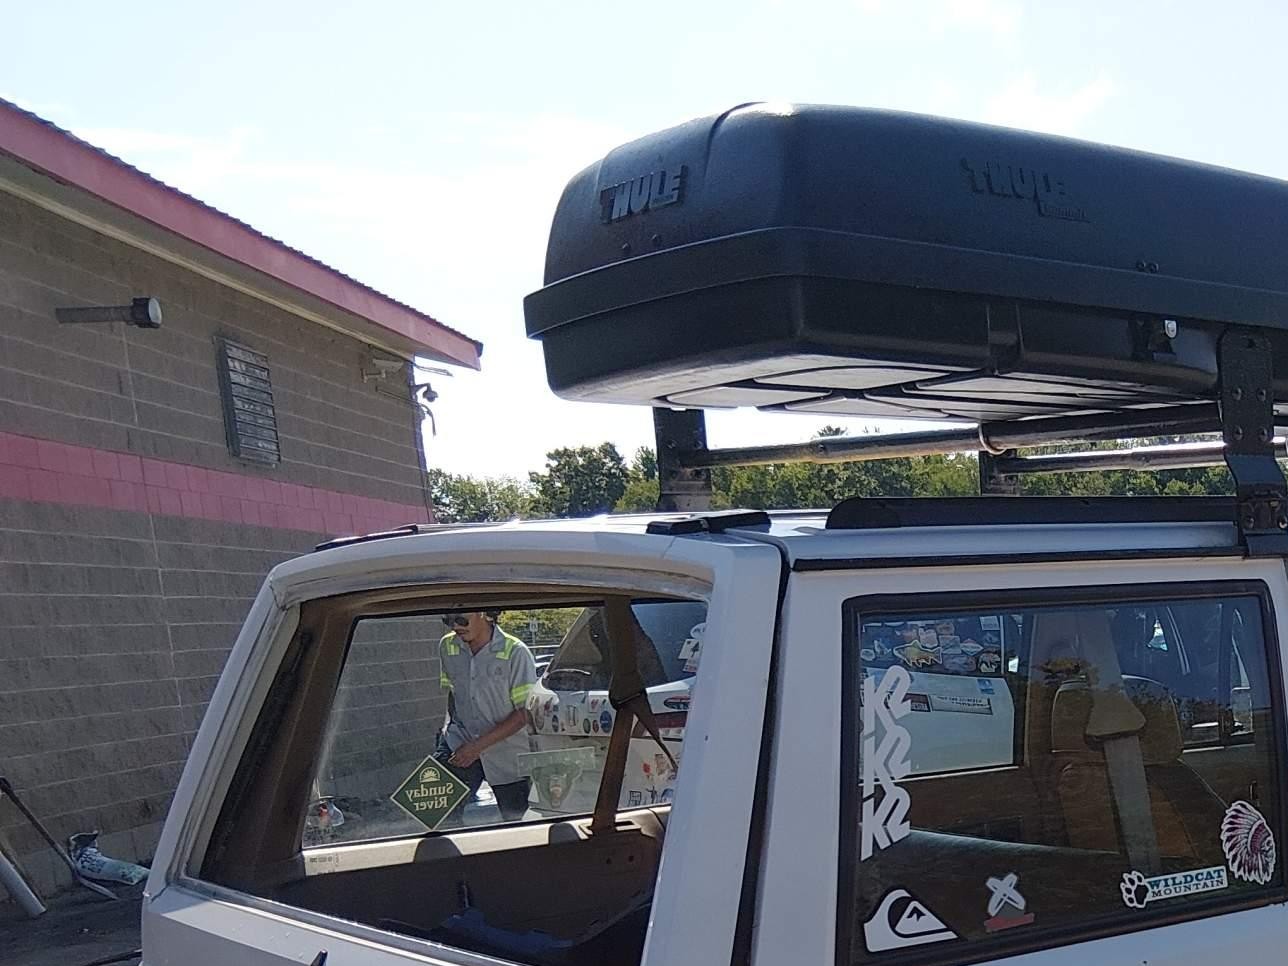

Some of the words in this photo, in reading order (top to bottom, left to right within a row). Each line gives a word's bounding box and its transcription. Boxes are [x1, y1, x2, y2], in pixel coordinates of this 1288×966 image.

[600, 165, 688, 224] THULE
[863, 664, 912, 737] K2
[863, 724, 912, 800] K2
[860, 786, 912, 861] K2
[1146, 868, 1225, 890] WILDCAT
[1151, 878, 1224, 898] MOUNTAIN
